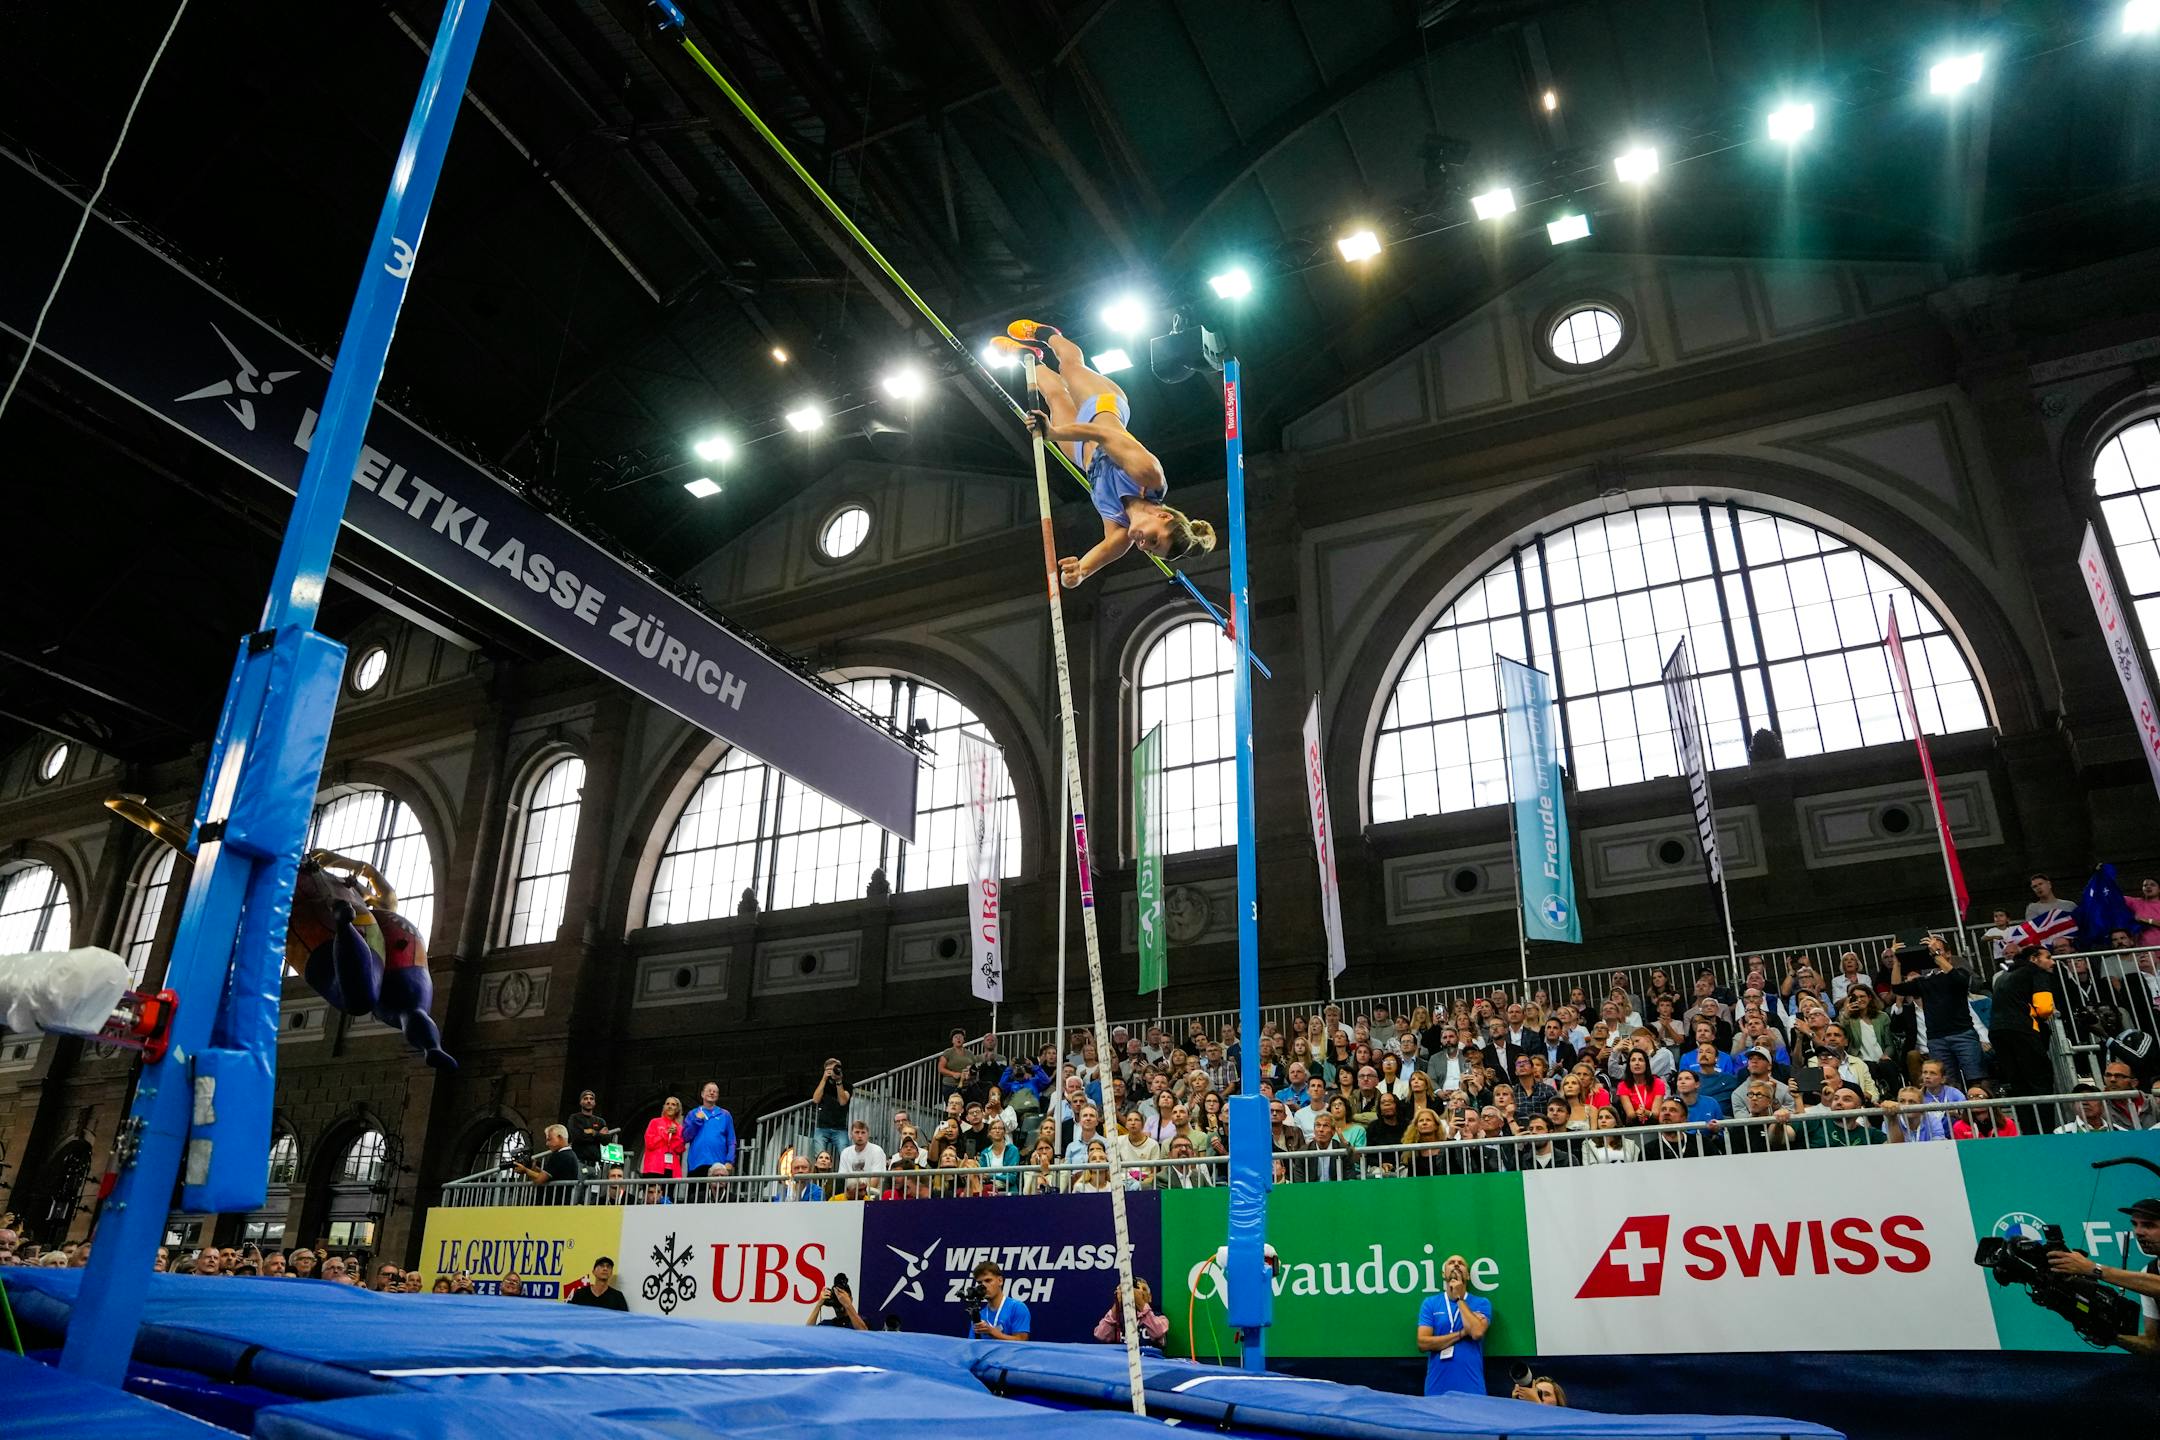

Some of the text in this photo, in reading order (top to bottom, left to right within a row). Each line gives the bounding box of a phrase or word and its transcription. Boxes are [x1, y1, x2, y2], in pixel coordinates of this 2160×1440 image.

[384, 235, 414, 279] 3
[609, 605, 748, 711] ZÜRICH
[1537, 795, 1560, 881] Freude
[1998, 1215, 2046, 1232] BMW
[436, 1232, 565, 1276] LE GRUYÈRE
[945, 1244, 1136, 1271] WELTKLASSE
[1273, 1244, 1499, 1296] vaudoie
[1682, 1215, 1931, 1281] SWISS
[710, 1243, 826, 1304] UBS
[944, 1273, 1055, 1303] ZICH
